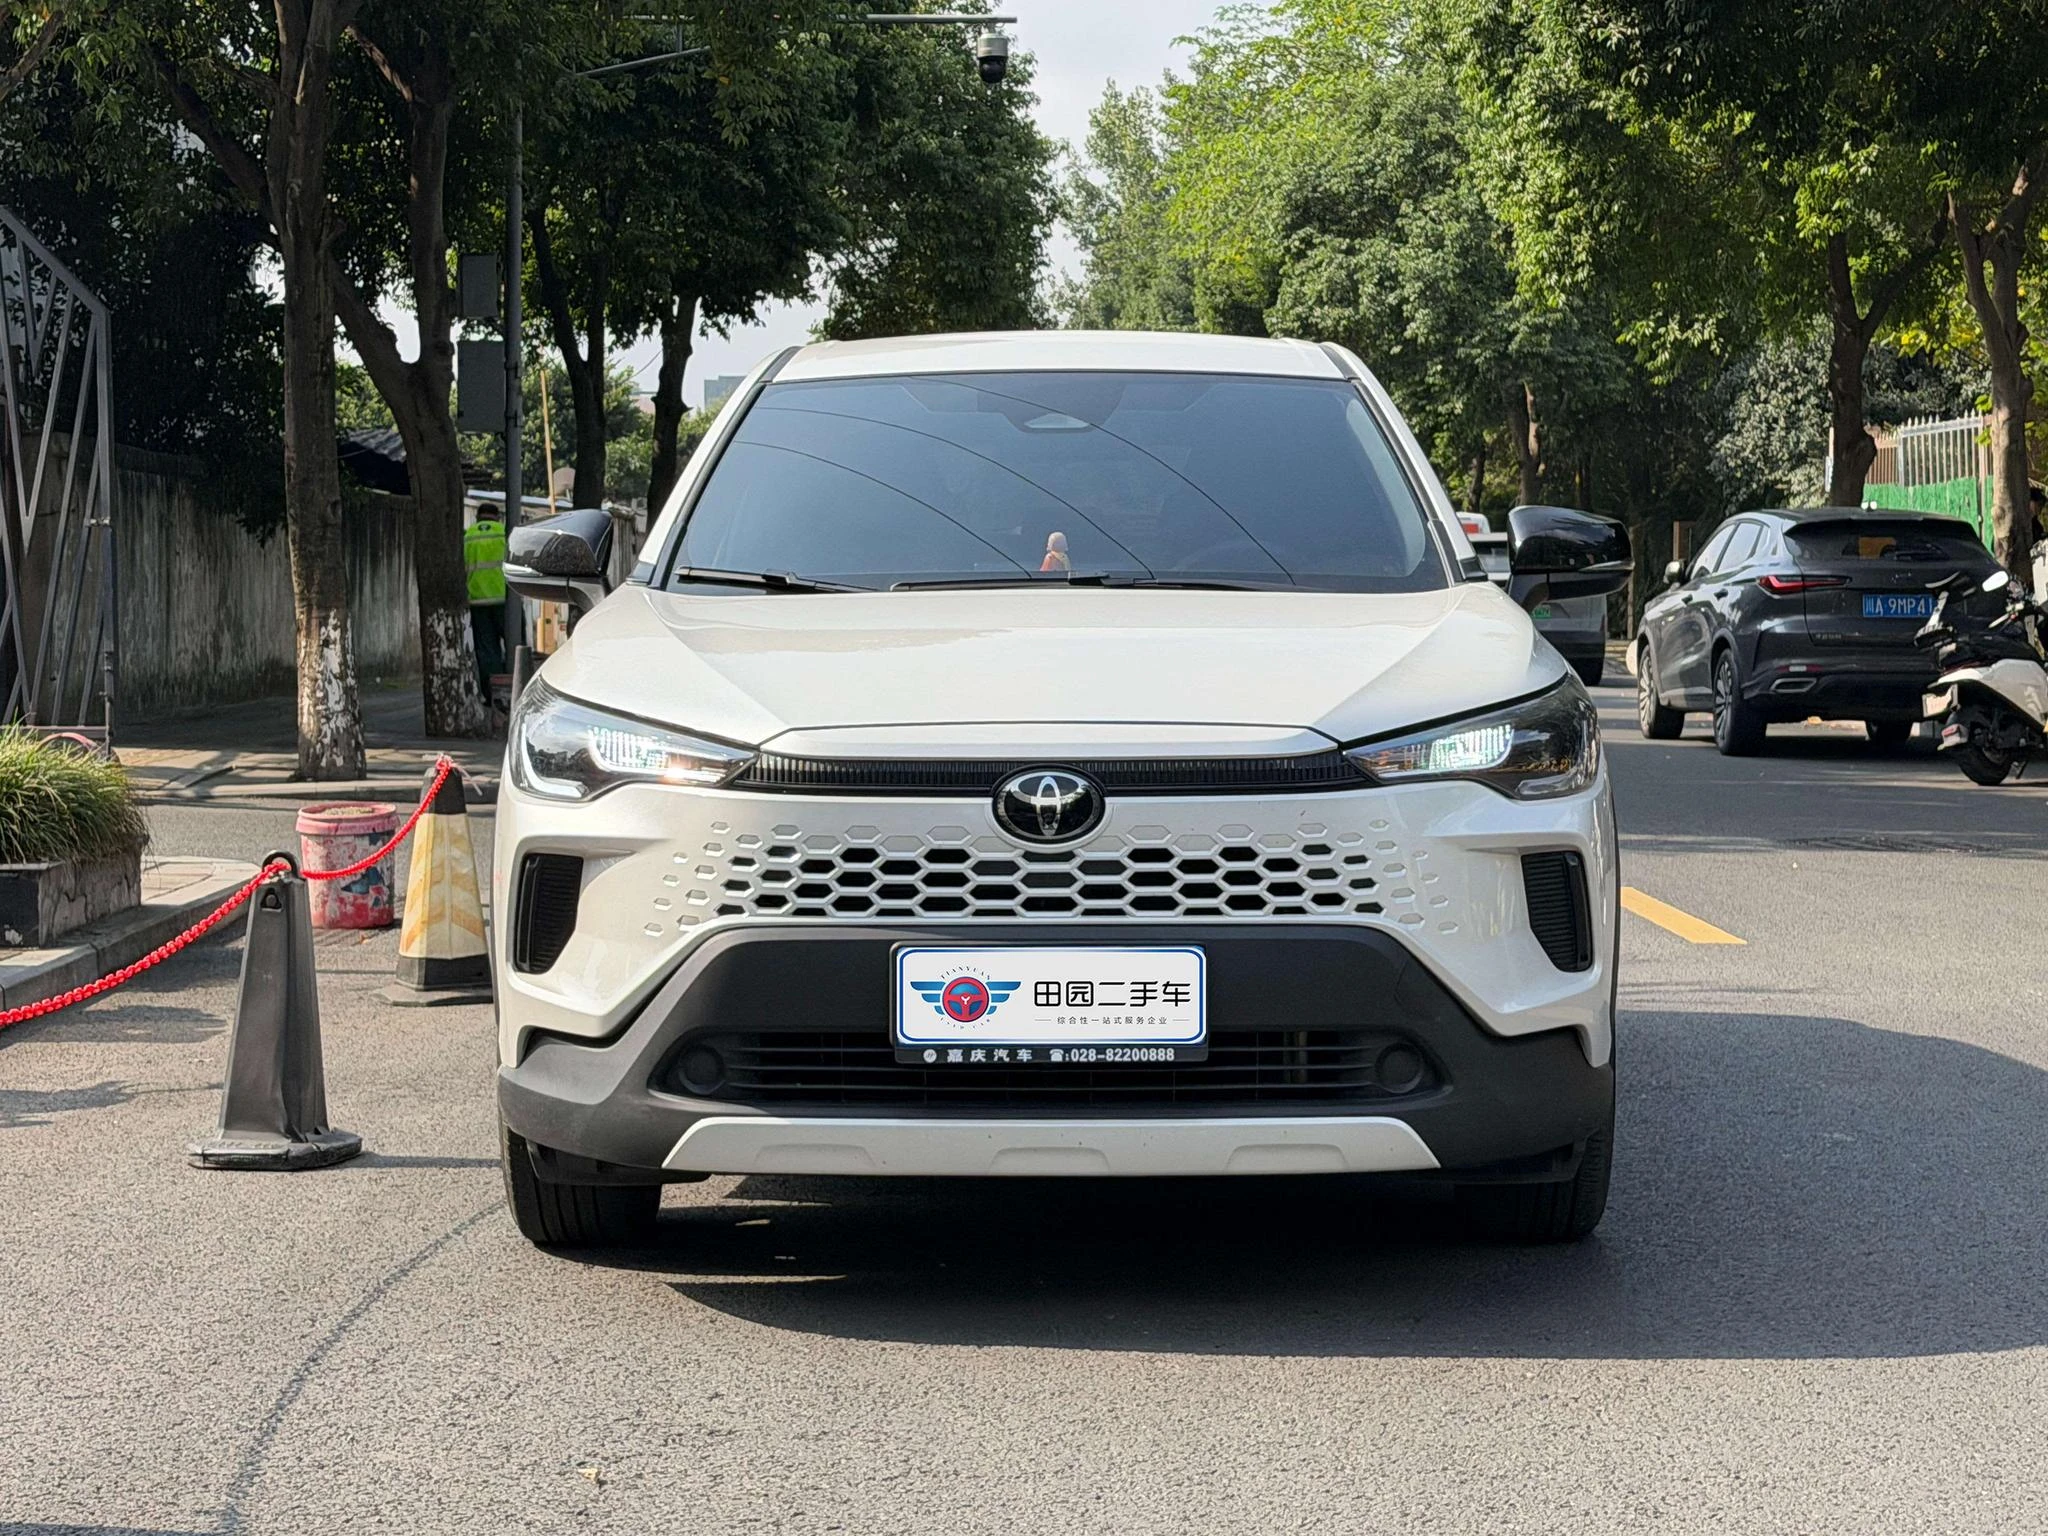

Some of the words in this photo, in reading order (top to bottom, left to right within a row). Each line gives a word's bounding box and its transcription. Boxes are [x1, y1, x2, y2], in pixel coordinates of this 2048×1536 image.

[1034, 980, 1192, 1007] 田园二手车
[1057, 1016, 1168, 1025] 综合性一站式服务企业
